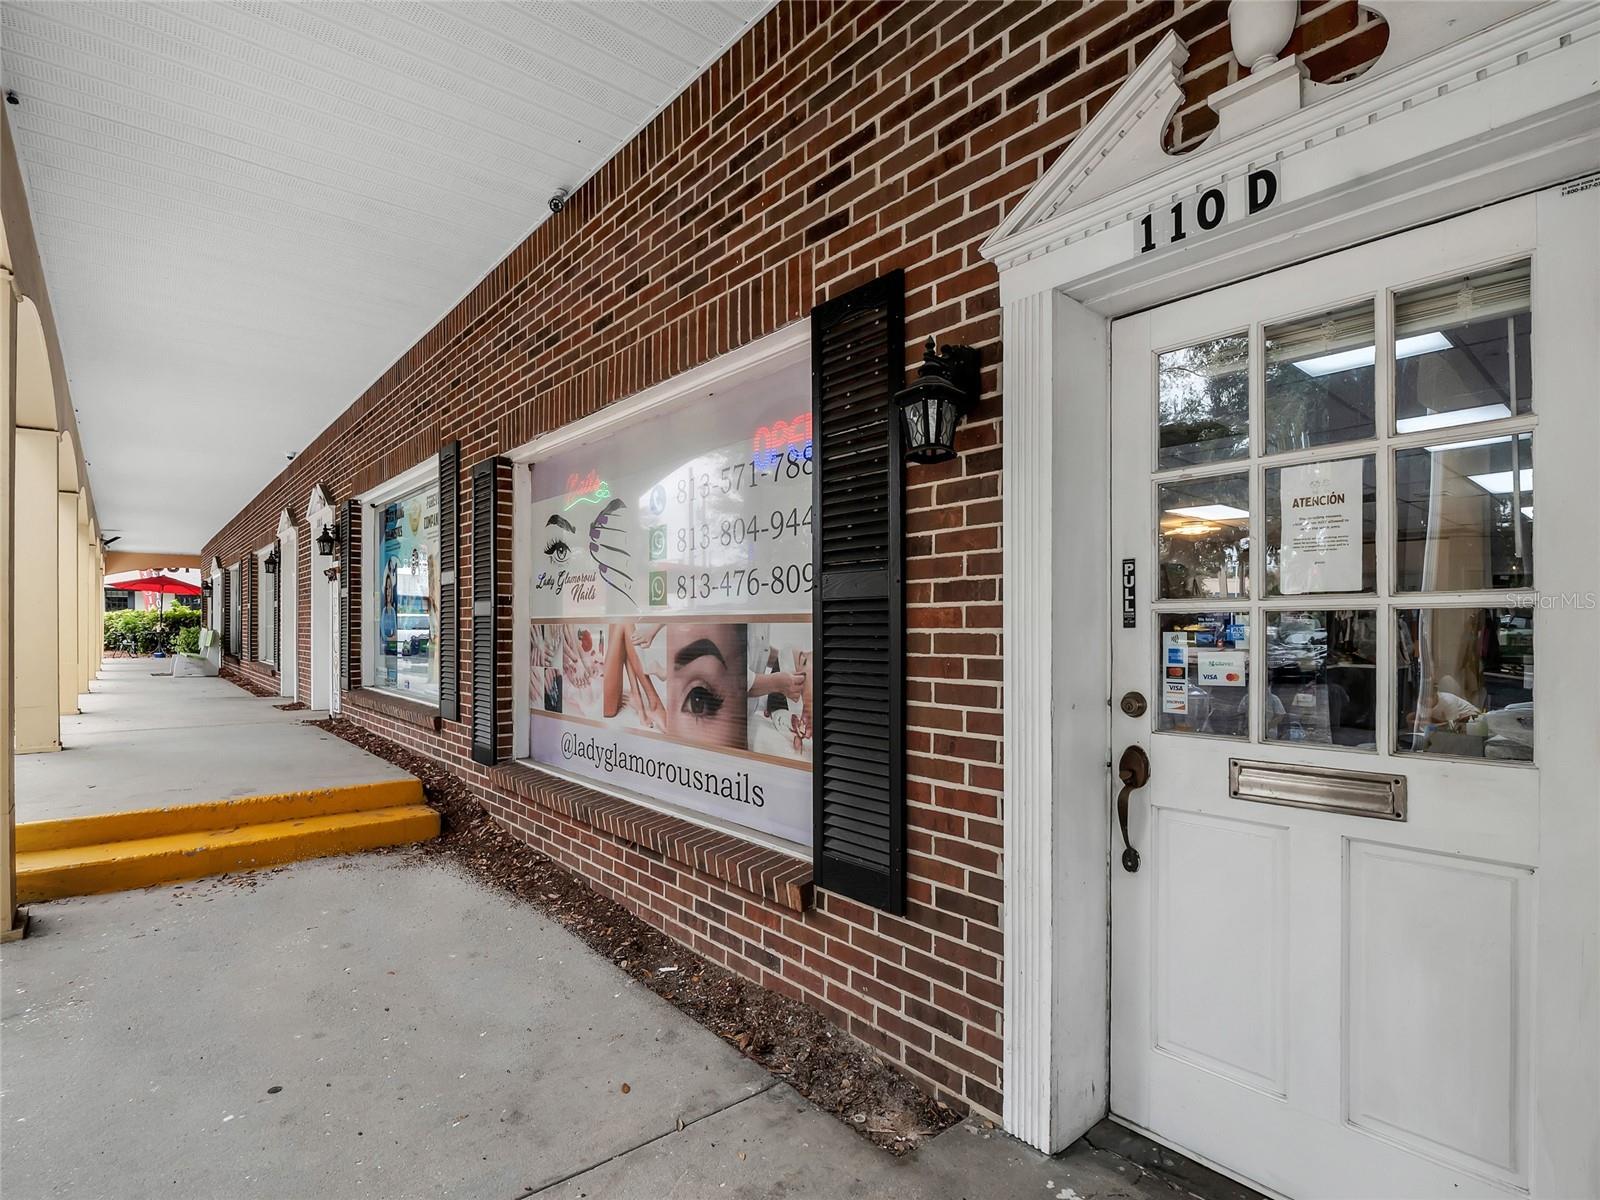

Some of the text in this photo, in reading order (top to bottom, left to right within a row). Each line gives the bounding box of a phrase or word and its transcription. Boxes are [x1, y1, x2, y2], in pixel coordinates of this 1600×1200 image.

[1141, 169, 1277, 254] 110 D
[752, 411, 812, 472] OPE
[1292, 491, 1345, 508] ATENCIÓN
[676, 505, 812, 553] 813-804-944
[536, 570, 597, 595] Lady Glamorous
[571, 583, 597, 603] Nails
[676, 563, 812, 600] 813-476-809
[1123, 563, 1135, 612] PULL
[1203, 673, 1218, 681] VISA
[561, 731, 766, 808] @ladyglamorousnails
